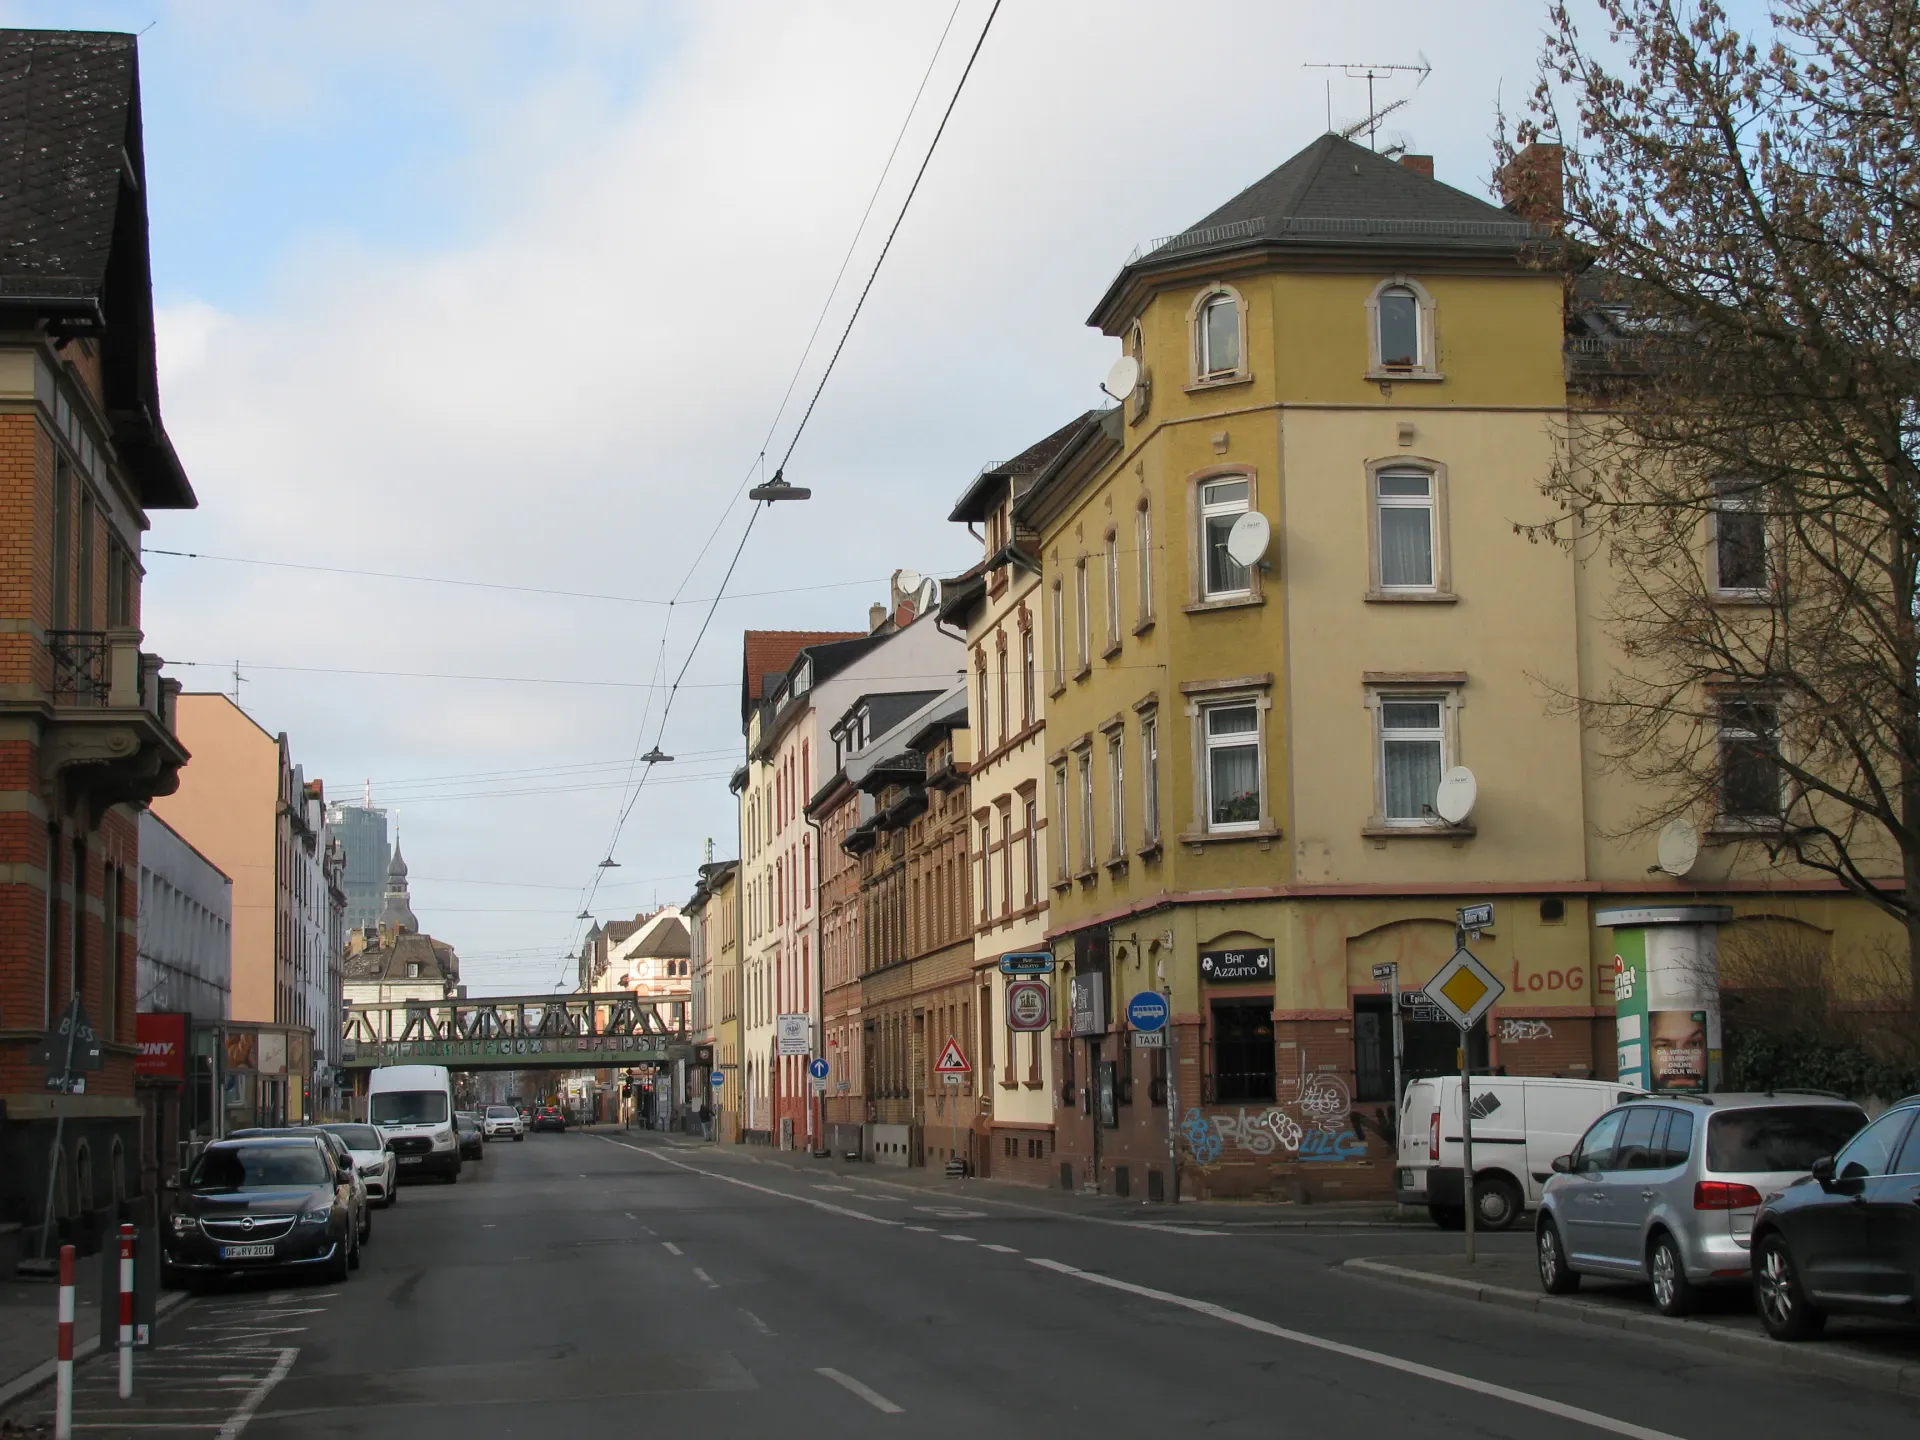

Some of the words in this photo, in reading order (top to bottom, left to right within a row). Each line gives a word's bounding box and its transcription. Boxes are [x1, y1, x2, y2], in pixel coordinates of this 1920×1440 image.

[1224, 953, 1245, 964] Bar
[1213, 966, 1257, 978] Azzurro
[1138, 1036, 1160, 1045] TAXI
[226, 1247, 236, 1257] OF
[241, 1247, 252, 1256] RY
[253, 1246, 274, 1255] 2016
